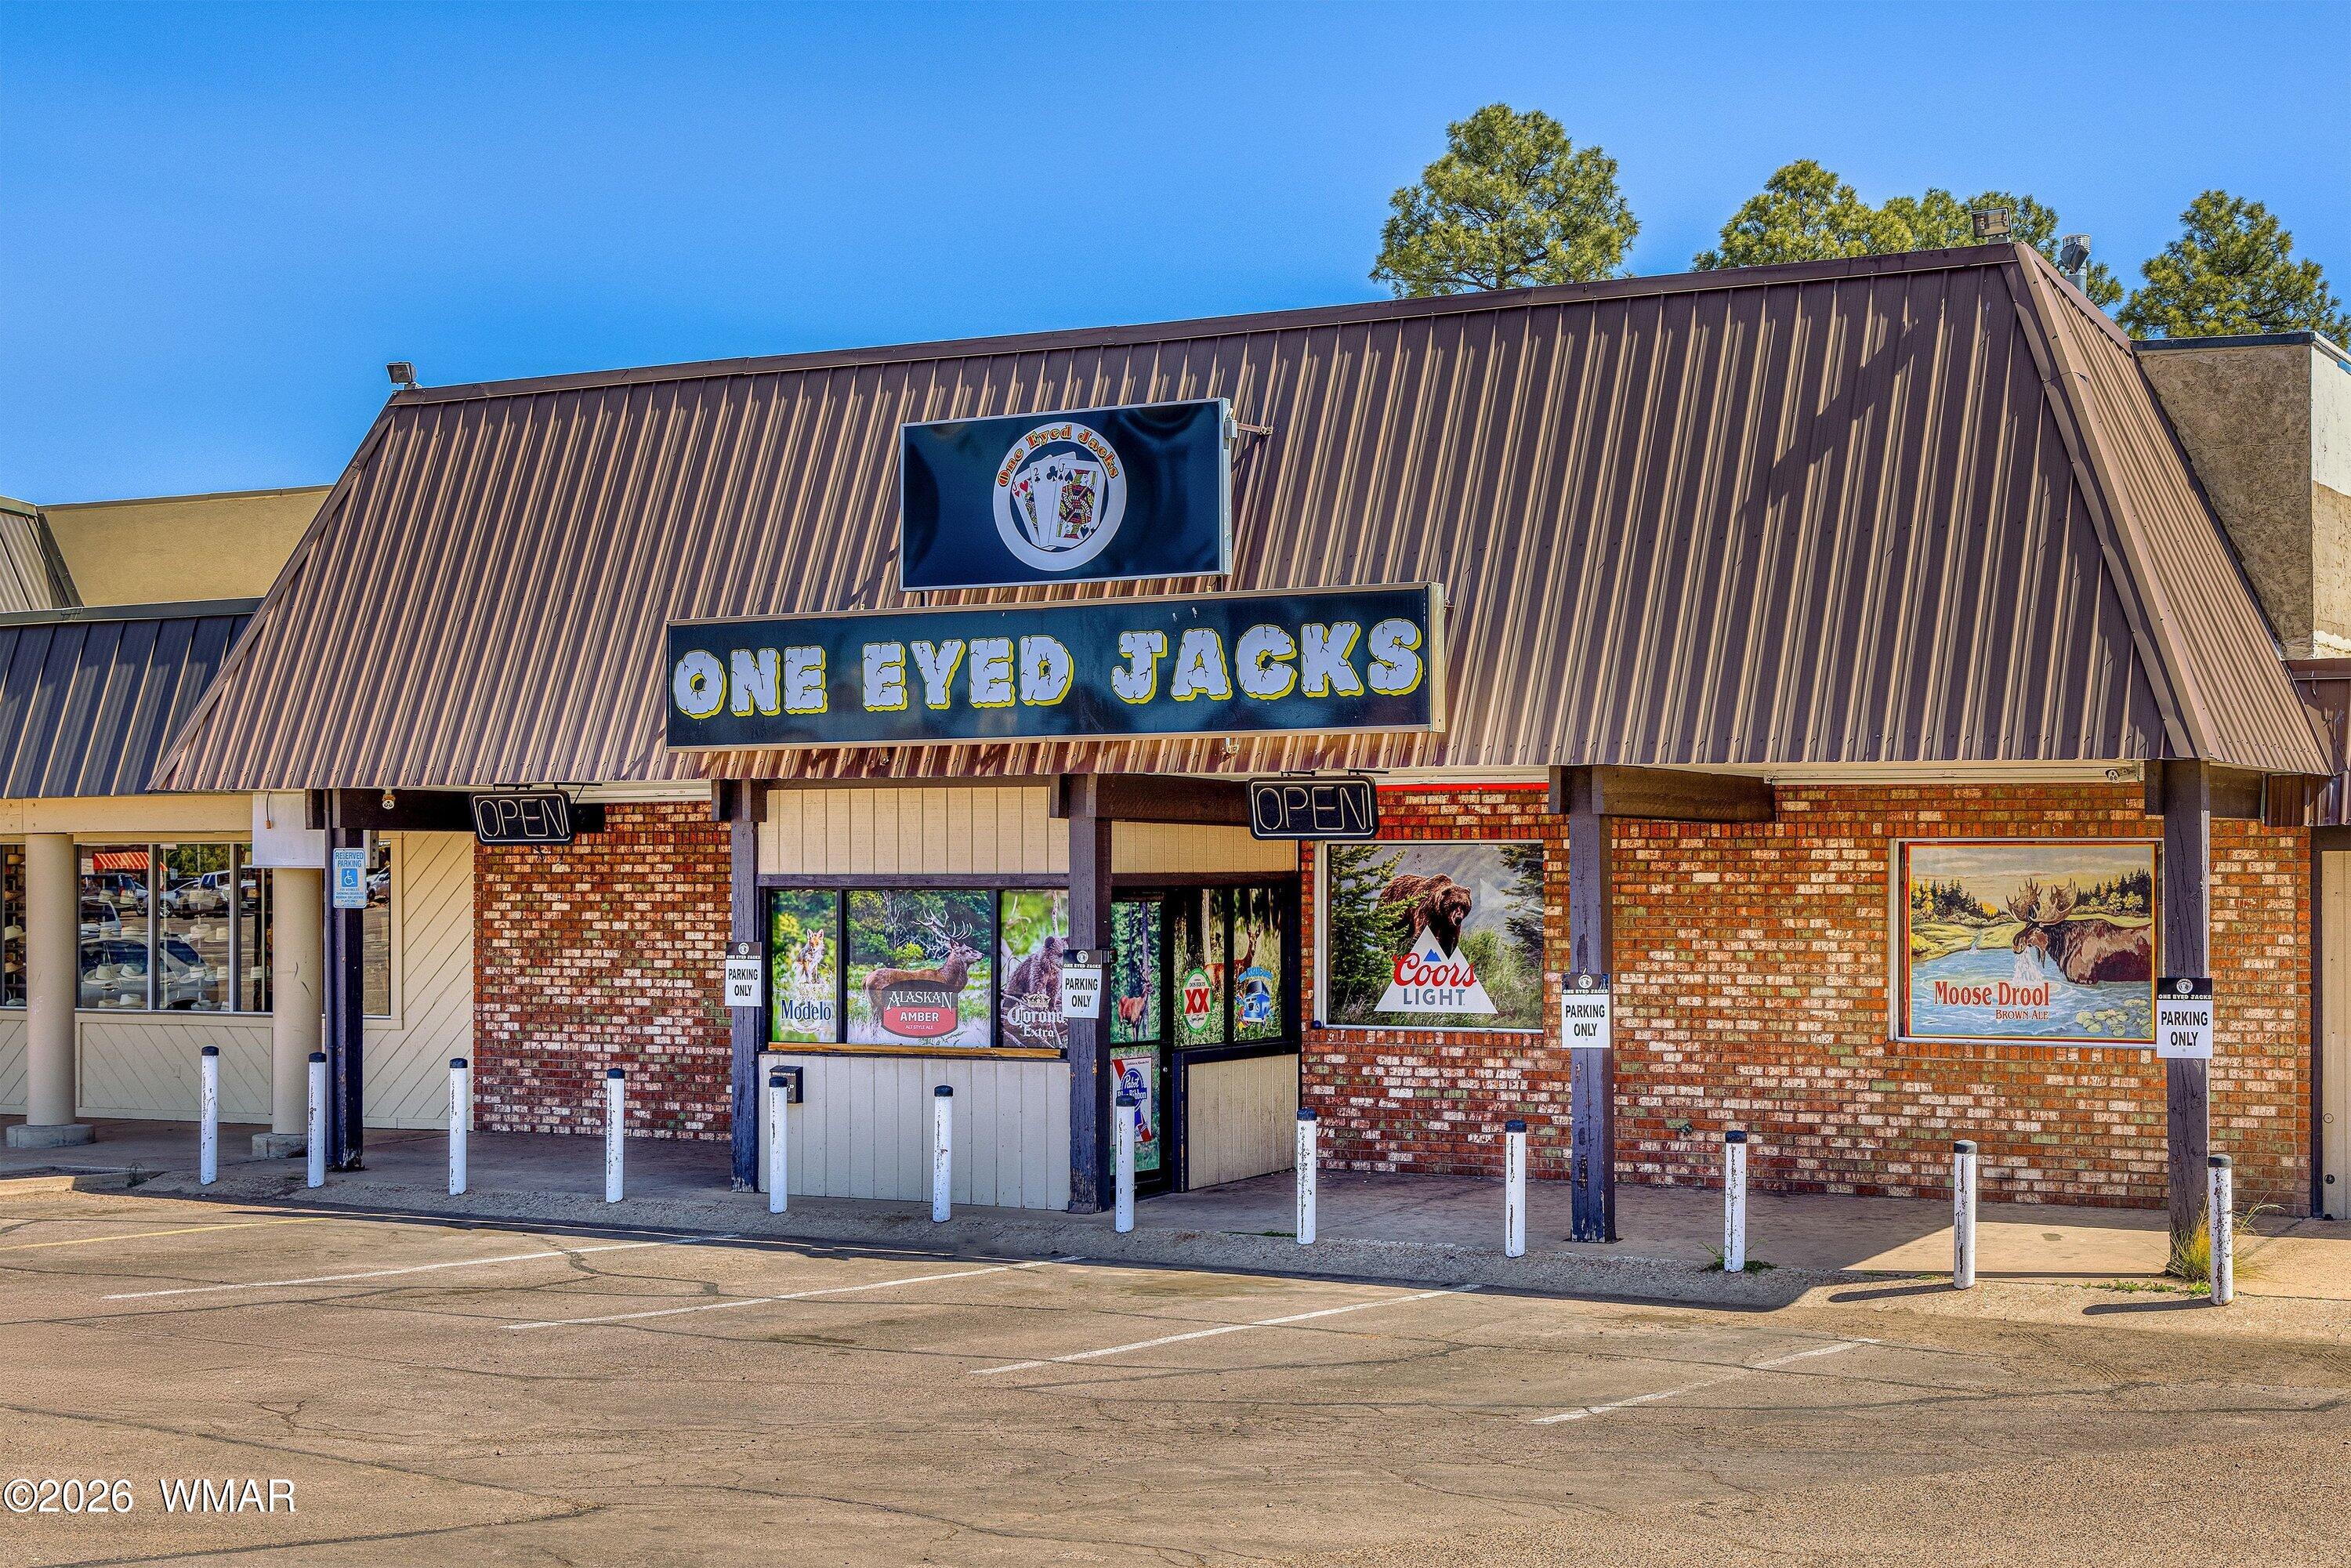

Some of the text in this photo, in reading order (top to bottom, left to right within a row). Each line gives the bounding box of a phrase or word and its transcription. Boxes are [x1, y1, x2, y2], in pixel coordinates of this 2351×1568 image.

[998, 425, 1119, 487] One Eyed Jacks
[672, 617, 1422, 719] ONE EYED JACKS
[1256, 787, 1367, 830] OPEN
[478, 799, 565, 837] OPEN
[728, 969, 758, 980] PARKING
[1392, 952, 1477, 987] Coors
[734, 985, 752, 996] ONLY
[1065, 978, 1098, 990] PARKING
[1404, 988, 1465, 1005] LIGHT
[1934, 980, 2049, 1006] Moose Drool
[885, 990, 953, 1013] ALASKAN
[1071, 995, 1092, 1008] ONLY
[1184, 988, 1210, 1014] XX
[781, 999, 831, 1020] Modelo
[900, 1012, 940, 1022] AMBER
[1565, 1005, 1605, 1018] PARKING
[1995, 1009, 2049, 1019] BROWN ALE
[2161, 1011, 2208, 1026] PARKING
[1023, 1027, 1055, 1037] Extra
[1574, 1023, 1597, 1036] ONLY
[2170, 1031, 2198, 1046] ONLY
[1124, 1074, 1139, 1089] Pabst
